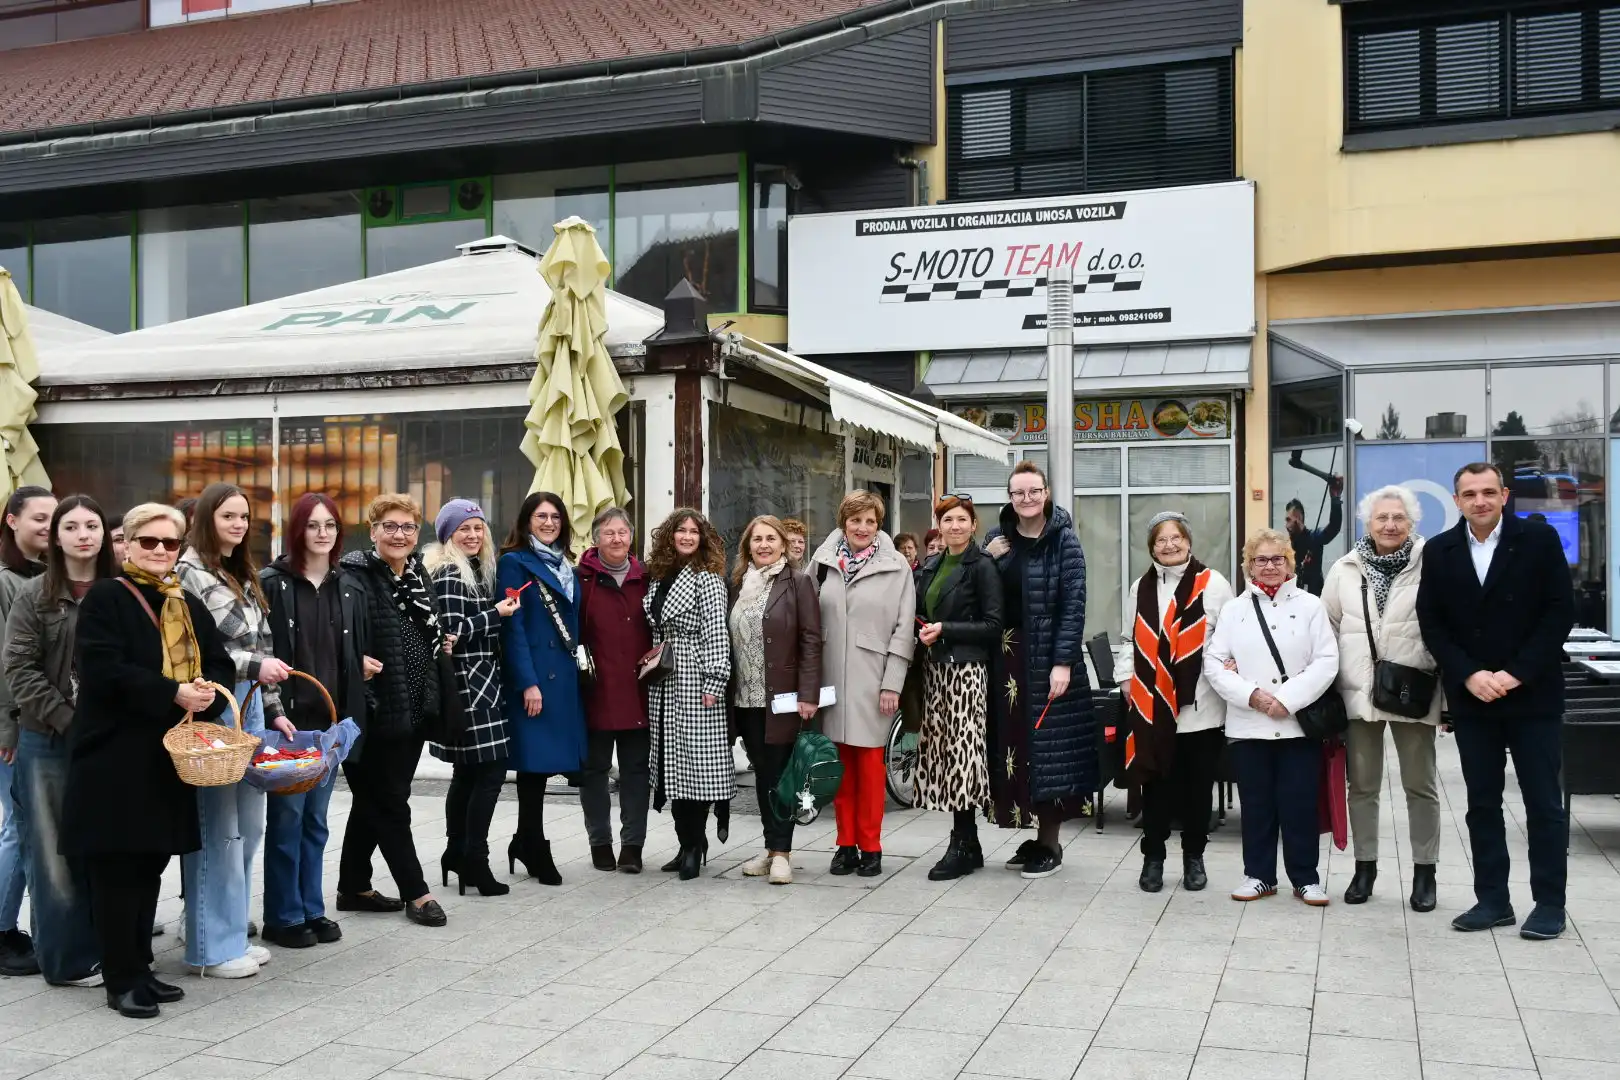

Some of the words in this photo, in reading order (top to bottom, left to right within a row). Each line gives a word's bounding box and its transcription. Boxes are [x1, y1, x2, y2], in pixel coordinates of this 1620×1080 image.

[863, 220, 908, 233] PRODAJA
[910, 217, 948, 230] VOZILA
[950, 216, 955, 228] I
[957, 211, 1033, 228] ORGANIZACIJA
[1035, 208, 1073, 222] UNOSA
[1075, 205, 1117, 220] VOZILA
[884, 246, 994, 283] S-MOTO
[1003, 241, 1084, 277] TEAM
[1087, 247, 1145, 272] d.o.o.
[258, 301, 479, 331] PAN
[1098, 315, 1117, 324] mob.
[1119, 311, 1164, 322] 098241069
[1023, 400, 1150, 433] BSHA
[1077, 432, 1109, 440] TURSKA
[1110, 430, 1150, 439] BAKLAVA
